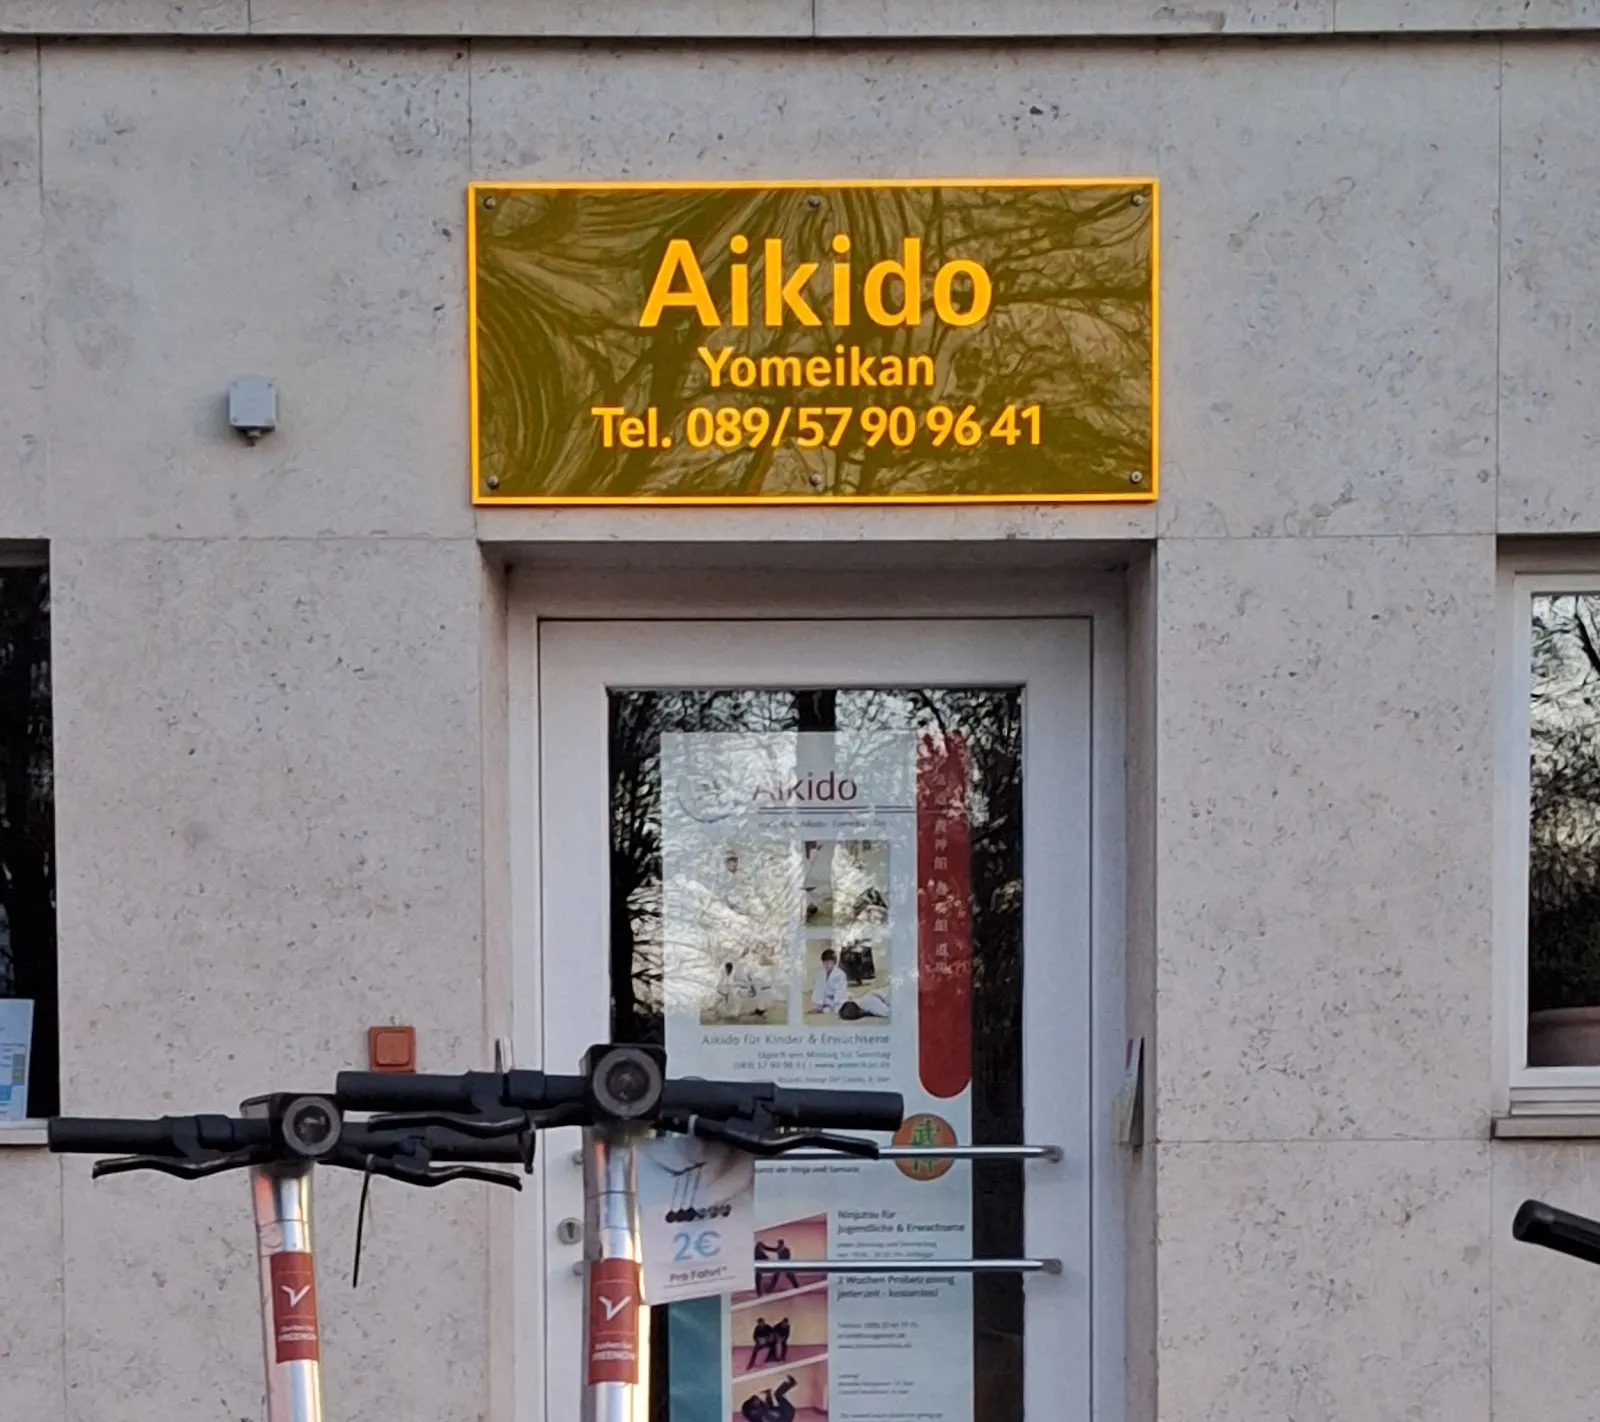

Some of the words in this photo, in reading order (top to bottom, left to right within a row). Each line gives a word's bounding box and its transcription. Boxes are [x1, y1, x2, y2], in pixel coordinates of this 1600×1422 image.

[639, 234, 993, 328] Aikido
[698, 345, 935, 388] Yomeikan
[592, 406, 672, 449] Tel.
[687, 406, 852, 449] 089/57
[860, 405, 916, 448] 90
[926, 404, 981, 448] 96
[990, 404, 1042, 446] 41
[752, 770, 858, 801] Aikido
[702, 1033, 740, 1045] Aikido
[743, 1033, 761, 1045] für
[765, 1033, 804, 1045] Kinder
[808, 1033, 818, 1045] &
[821, 1033, 891, 1045] Erwachsene
[673, 1229, 722, 1262] 2€
